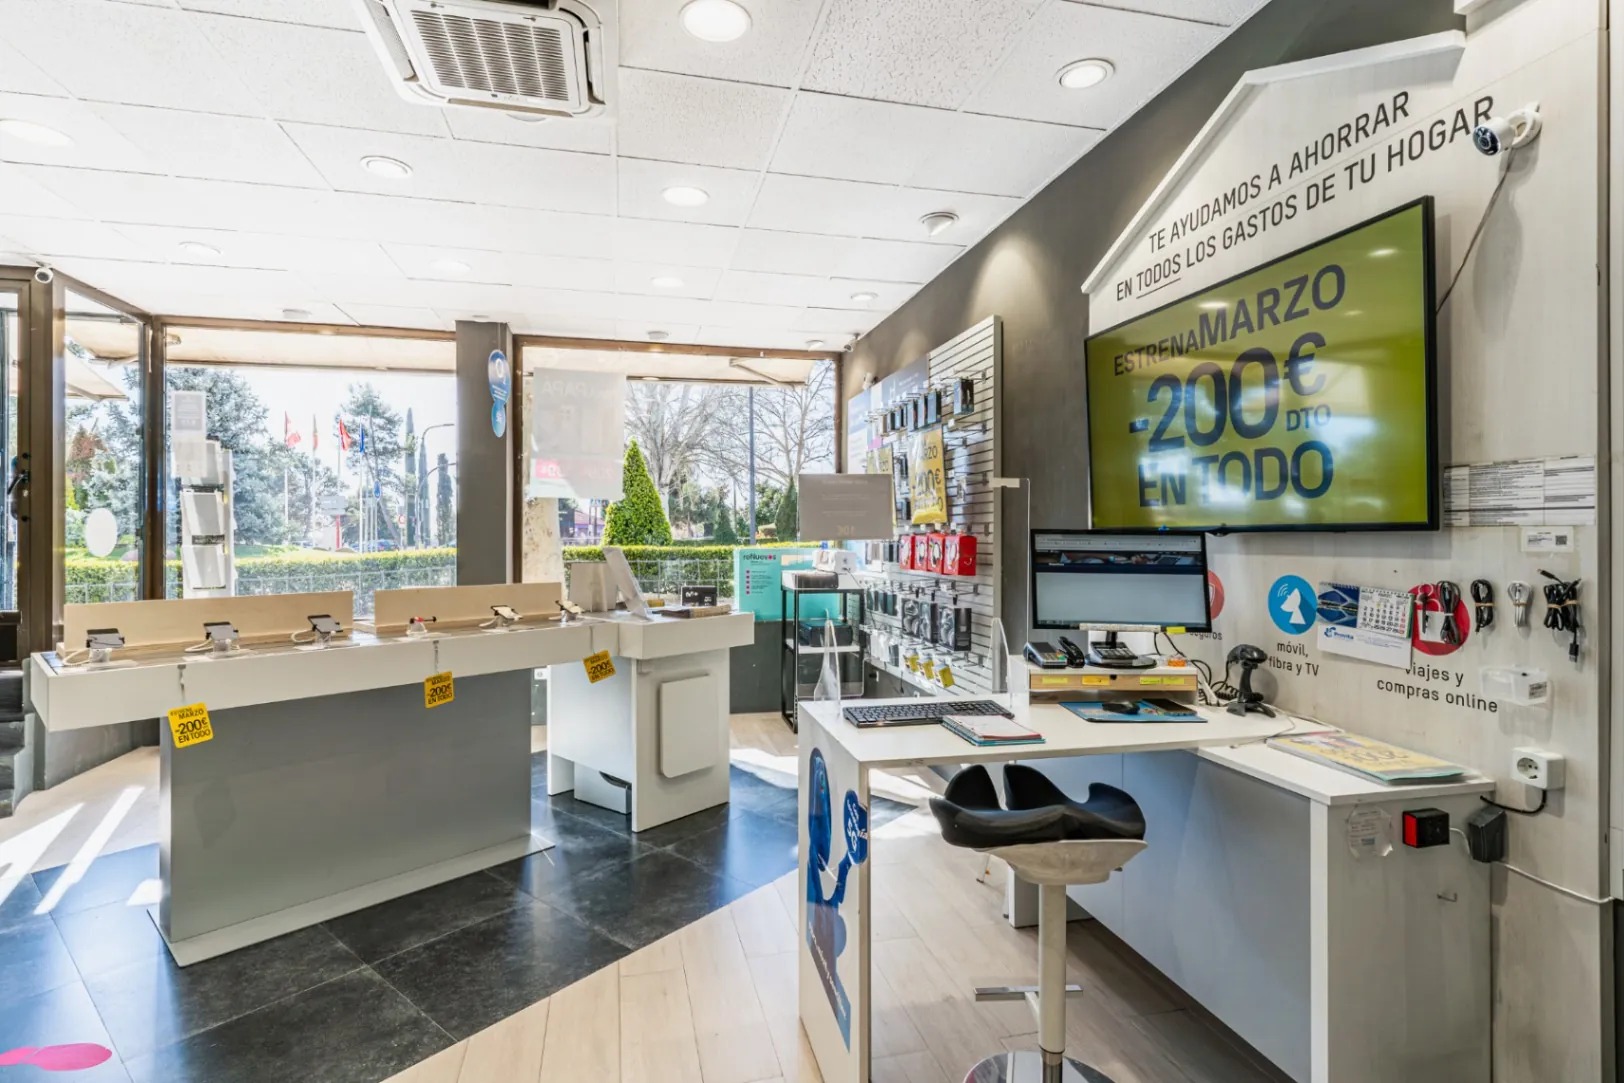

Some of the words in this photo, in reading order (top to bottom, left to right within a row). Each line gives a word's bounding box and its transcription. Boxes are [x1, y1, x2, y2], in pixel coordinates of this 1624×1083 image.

[1148, 230, 1166, 254] TE
[1169, 174, 1261, 243] AYUDAMOS
[1267, 163, 1282, 191] A
[1288, 90, 1410, 180] AHORRAR
[1116, 277, 1133, 302] EN
[1136, 254, 1182, 292] TODOS
[1185, 235, 1217, 268] LOS
[1222, 194, 1298, 250] GASTOS
[1305, 173, 1336, 211] DE
[1343, 153, 1376, 192] TU
[1387, 95, 1494, 173] HOGAR
[1114, 328, 1199, 377] ESTRENA
[1199, 264, 1346, 350] MARZO
[1286, 403, 1332, 432] DTO
[1137, 461, 1187, 508] EN
[1192, 439, 1335, 505] TODO
[1276, 641, 1309, 658] móvil,
[1269, 656, 1293, 671] fibra
[1296, 663, 1302, 676] y
[1305, 662, 1320, 676] TV
[1455, 672, 1464, 687] y
[1376, 679, 1440, 701] compras
[1445, 692, 1498, 713] online
[178, 735, 190, 744] EN
[190, 729, 211, 740] TODO
